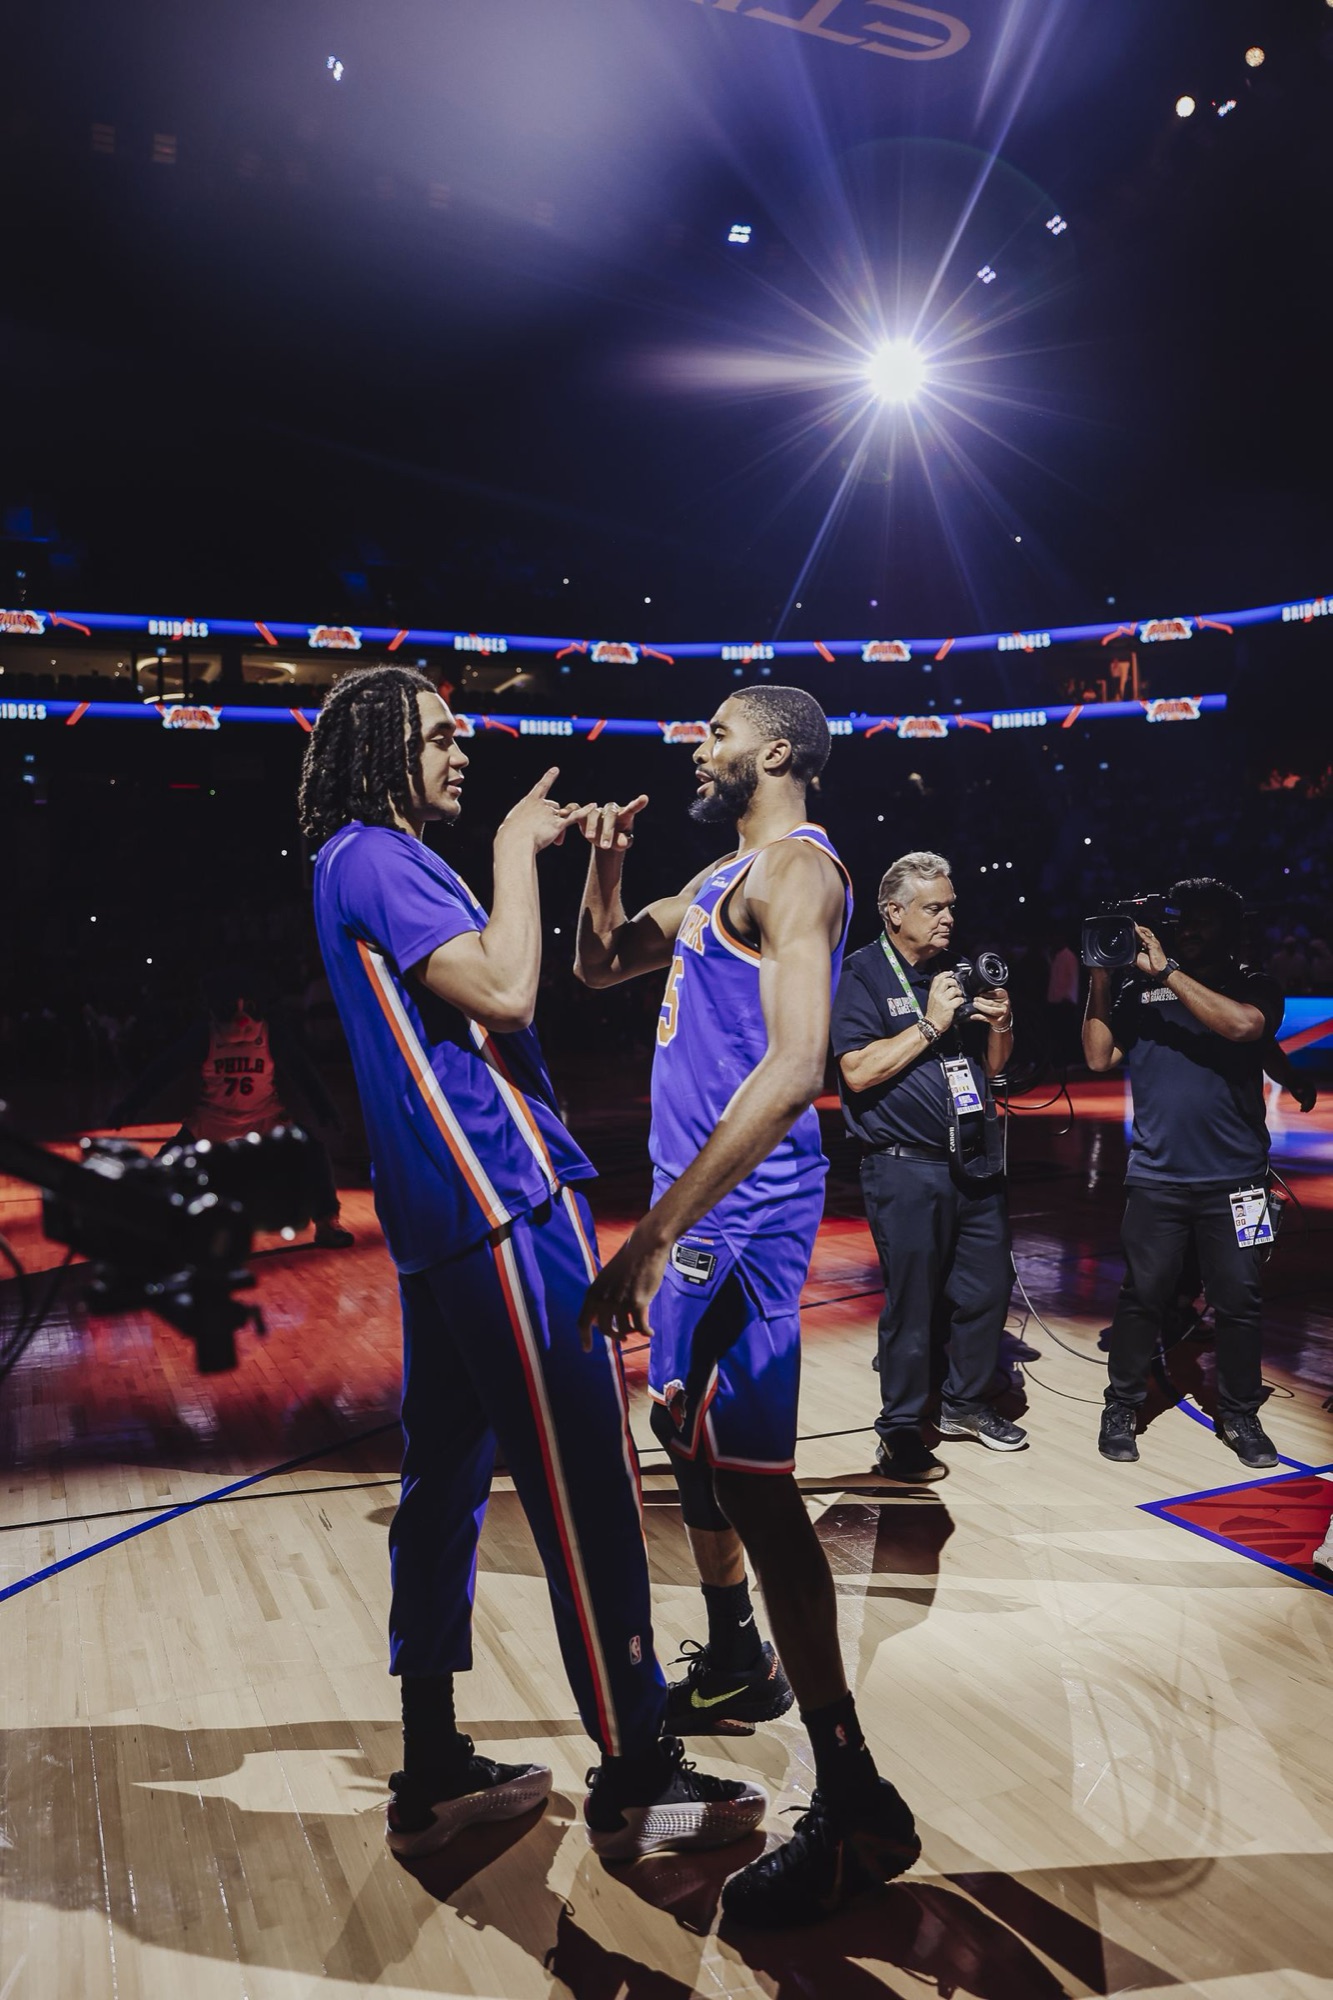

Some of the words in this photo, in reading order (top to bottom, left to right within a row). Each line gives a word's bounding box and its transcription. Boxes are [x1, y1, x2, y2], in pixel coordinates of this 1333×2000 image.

[1282, 599, 1333, 622] BRIDGES
[148, 619, 209, 638] BRIDGES
[454, 635, 508, 653] BRIDGES
[997, 632, 1051, 651] BRIDGES
[721, 644, 774, 660] BRIDGES
[520, 719, 573, 736] BRIDGES
[992, 711, 1047, 730] BRIDGES
[223, 1076, 255, 1097] 76
[949, 1126, 957, 1153] Canon
